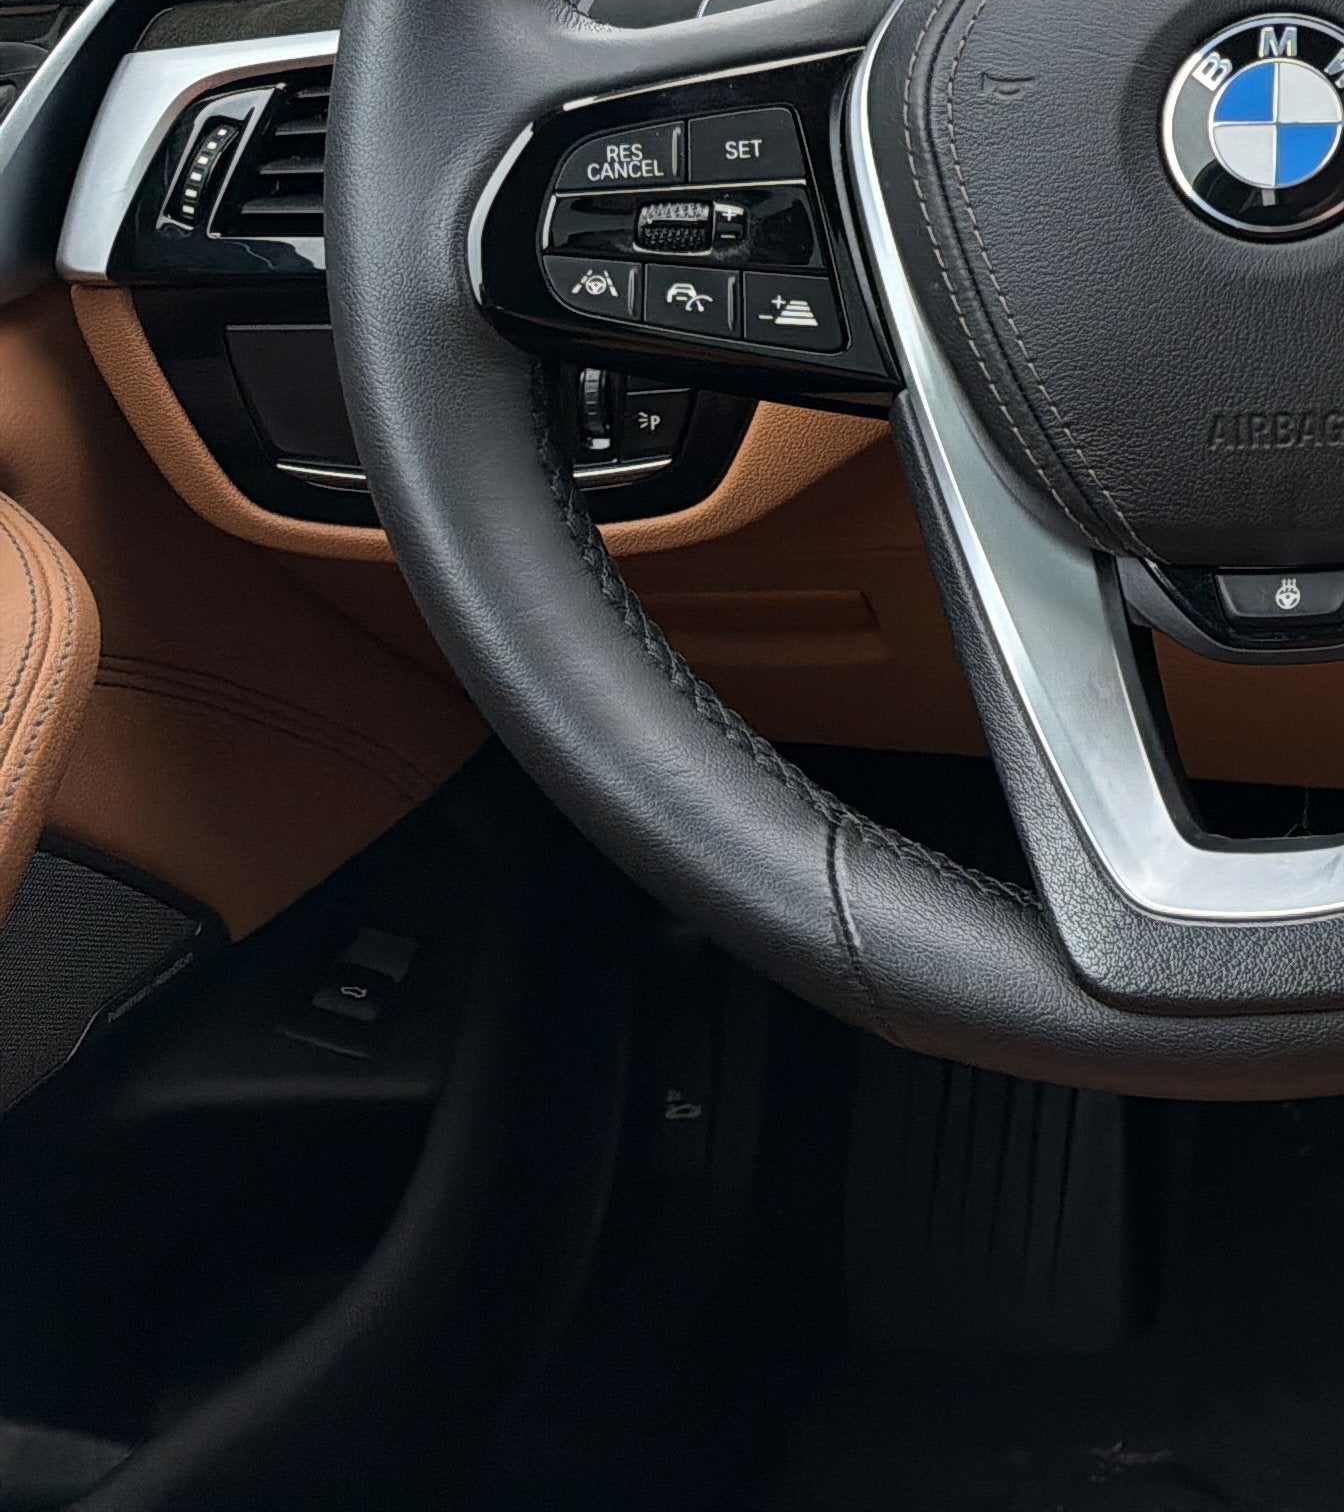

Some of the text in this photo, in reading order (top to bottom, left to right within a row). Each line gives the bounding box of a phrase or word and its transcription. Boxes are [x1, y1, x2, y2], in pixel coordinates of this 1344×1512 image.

[606, 143, 643, 162] RES
[724, 139, 763, 161] SET
[587, 159, 665, 182] CANCEL
